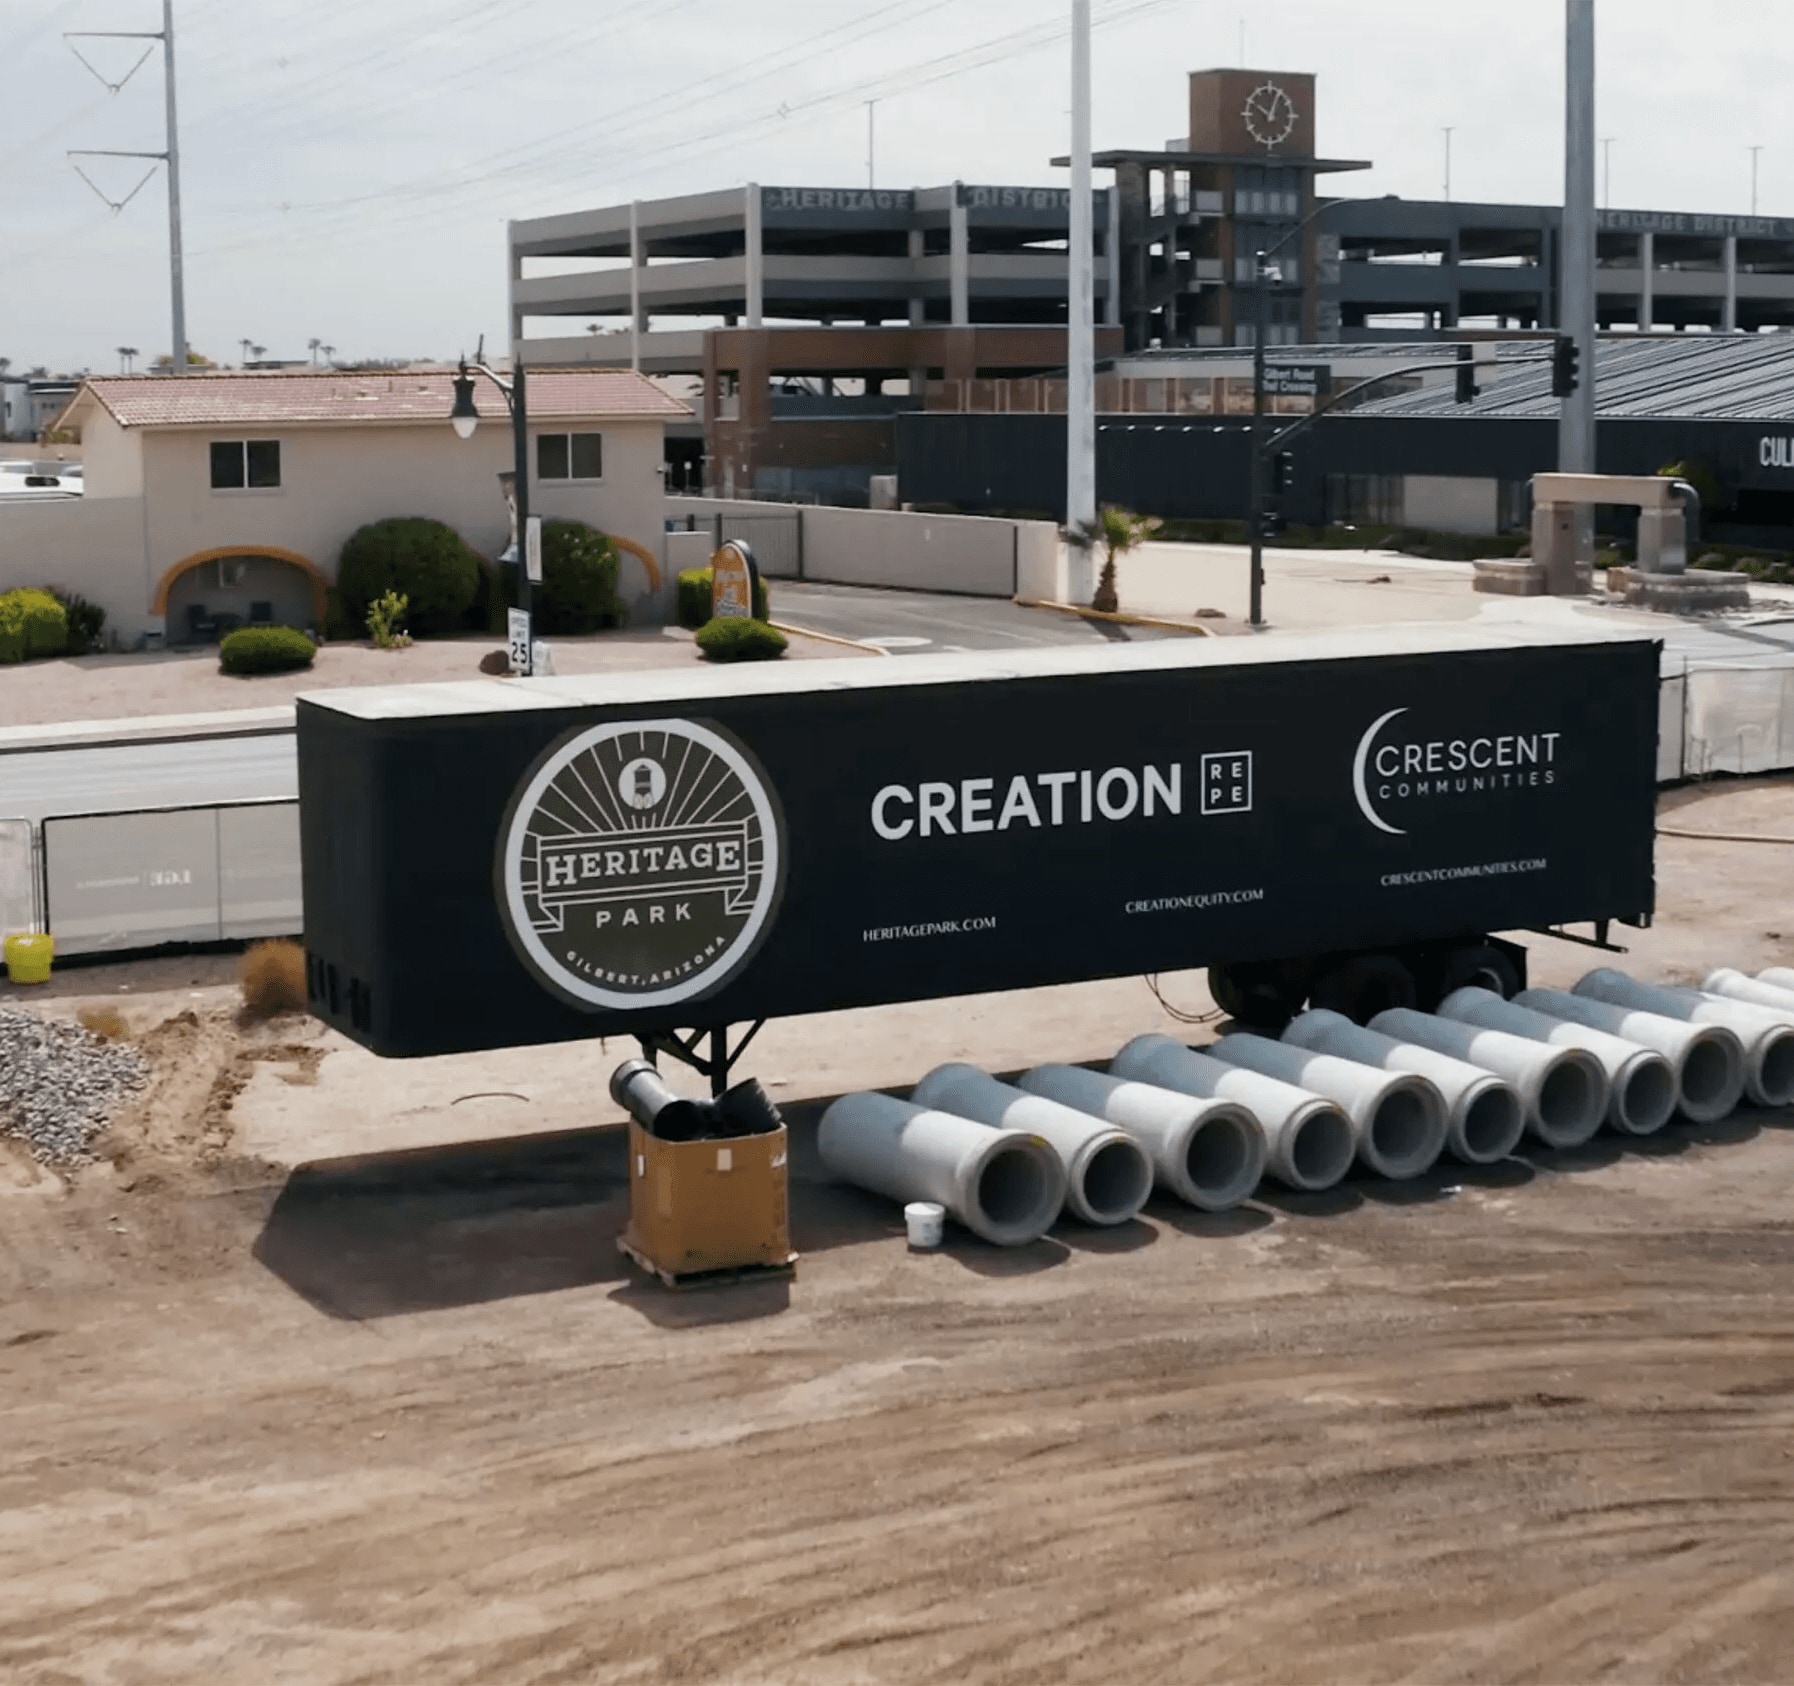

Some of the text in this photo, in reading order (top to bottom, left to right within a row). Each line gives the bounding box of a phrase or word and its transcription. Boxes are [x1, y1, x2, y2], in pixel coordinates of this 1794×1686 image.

[779, 187, 1070, 211] HERITAGE DISTRIC
[511, 641, 528, 664] 25
[1375, 732, 1561, 777] CRESCENT
[1379, 770, 1555, 799] COMMUNITIES
[871, 762, 1182, 841] CREATION
[546, 840, 741, 887] HERITAGE
[1380, 858, 1547, 886] CRESCENTCOMMUNITIES.COM
[1125, 888, 1264, 914] CREATIONEQUITY.COM
[596, 903, 692, 928] PARK
[863, 916, 996, 942] HERITAGEPARK.COM
[649, 936, 725, 984] ARIZONA
